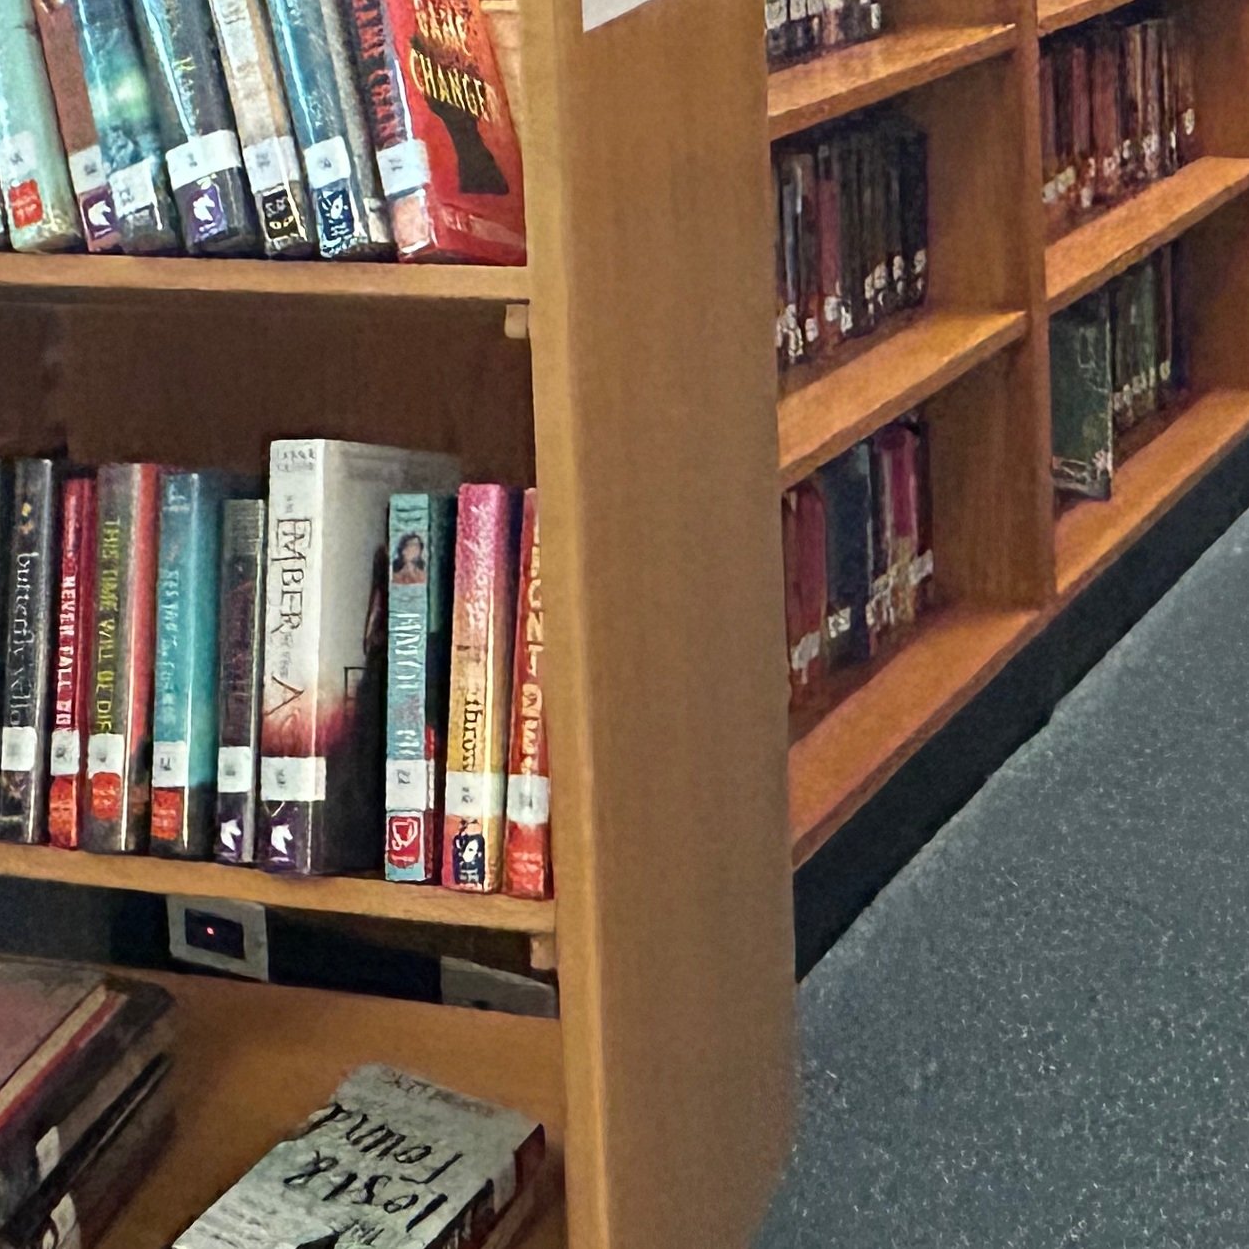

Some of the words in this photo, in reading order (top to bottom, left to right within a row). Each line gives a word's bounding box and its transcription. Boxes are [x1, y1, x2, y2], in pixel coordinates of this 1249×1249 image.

[102, 518, 121, 556] THIS
[100, 570, 118, 611] TIME
[271, 519, 311, 633] EMBER
[13, 552, 40, 655] butterfly
[59, 575, 77, 636] NEVER
[98, 618, 116, 662] WILL
[57, 646, 74, 690] FALL
[10, 666, 31, 727] yello
